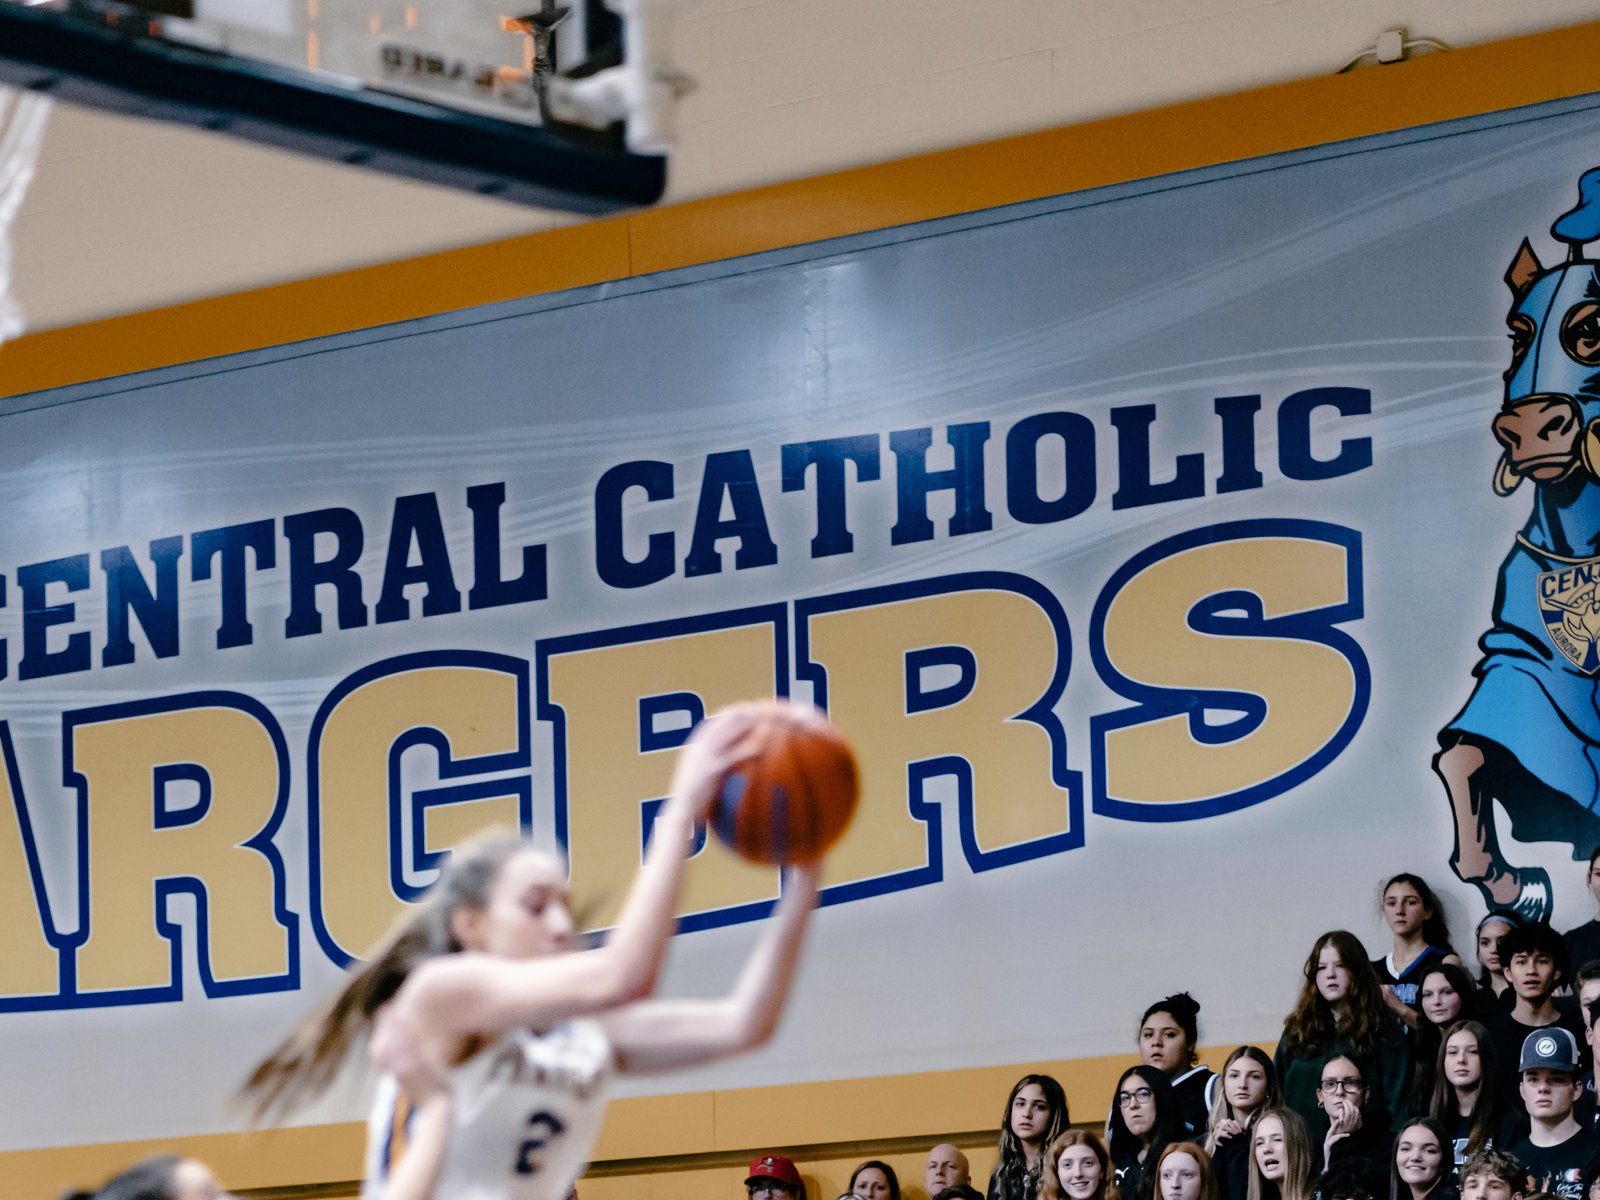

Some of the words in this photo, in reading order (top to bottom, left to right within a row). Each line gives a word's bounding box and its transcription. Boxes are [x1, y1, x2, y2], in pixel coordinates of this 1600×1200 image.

[0, 482, 548, 682] ENTRAL
[595, 387, 1373, 590] CATHOLIC
[1541, 563, 1600, 599] CEN
[1551, 627, 1582, 661] AURORA
[0, 518, 1371, 1014] RGERS
[515, 1111, 567, 1175] 2
